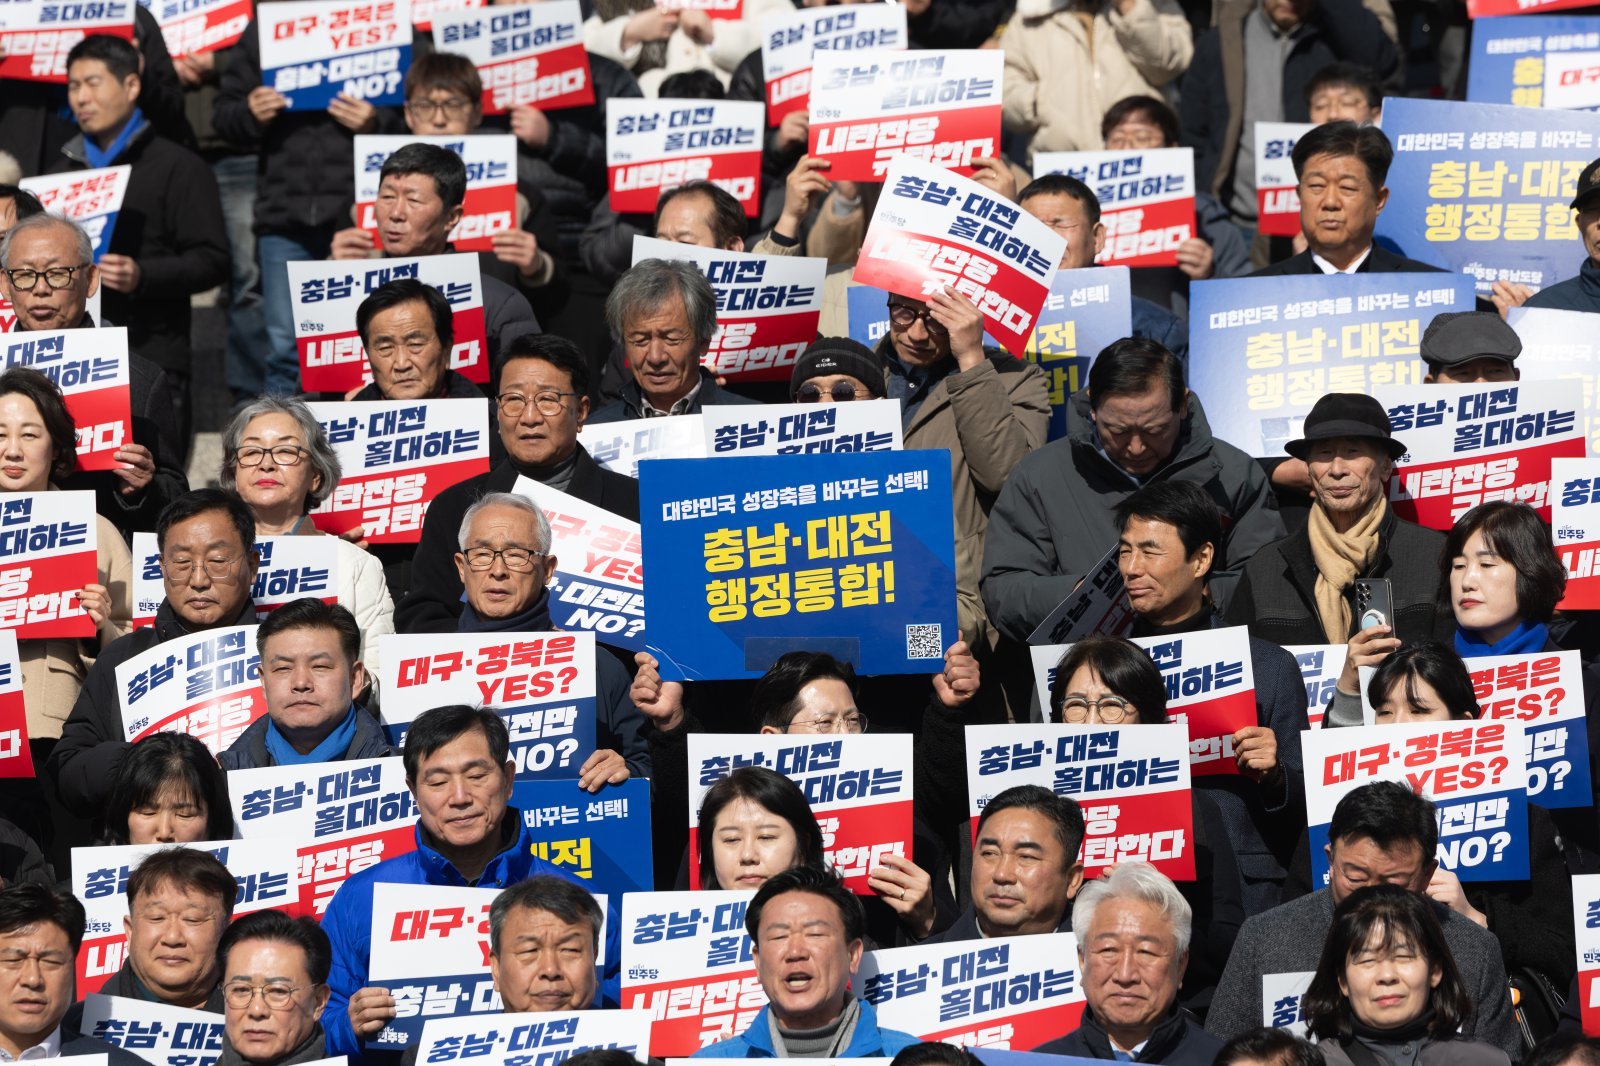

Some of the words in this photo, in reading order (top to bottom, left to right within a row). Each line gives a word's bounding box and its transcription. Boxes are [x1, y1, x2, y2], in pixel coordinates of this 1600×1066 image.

[273, 2, 395, 40] 대구·경북은
[331, 23, 398, 50] YES?
[443, 9, 531, 43] 충남·대전
[490, 21, 574, 57] 홀대하는
[343, 72, 402, 98] NO?
[822, 55, 945, 91] 충남·대전
[881, 76, 993, 110] 홀대하는
[616, 106, 715, 136] 충남·대전
[664, 126, 755, 152] 홀대하는
[1397, 133, 1465, 152] 대한민국
[1469, 130, 1538, 150] 성장축을
[1541, 131, 1593, 149] 바꾸는
[893, 175, 1021, 231] 충남·대전
[947, 215, 1052, 278] 홀대하는
[1070, 284, 1109, 307] 선택!
[1209, 304, 1278, 330] 대한민국
[1283, 297, 1353, 321] 성장축을
[1357, 293, 1410, 312] 바꾸는
[1414, 288, 1456, 305] 선택!
[300, 322, 324, 332] 민주당
[1246, 319, 1421, 369] 충남·대전
[320, 405, 427, 444] 남·대전
[1387, 387, 1518, 431] 충남·대전
[365, 429, 480, 468] 홀대하는
[715, 408, 837, 452] 충남·대전
[1454, 409, 1575, 452] 홀대하는
[662, 495, 736, 522] 대한민국
[742, 484, 817, 512] 성장축을
[822, 478, 879, 501] 바꾸는
[885, 469, 929, 494] 선택!
[703, 509, 893, 573] 충남·대전
[1557, 528, 1585, 539] 민주당
[705, 560, 896, 623] 행정통합!
[564, 608, 645, 639] NO?
[128, 630, 246, 705] 충남·대전
[397, 636, 575, 689] 대구·경북은
[476, 666, 578, 705] YES?
[129, 717, 149, 735] 민주당
[978, 730, 1119, 776] 충남·대전
[1323, 724, 1505, 786] 대구·경북은
[242, 764, 382, 820] 충남·대전
[800, 767, 903, 805] 대하는
[1053, 756, 1180, 795] 홀대하는
[1405, 756, 1509, 796] YES?
[1526, 761, 1571, 797] O?
[314, 790, 421, 838] 홀대하
[524, 806, 579, 828] 바꾸는
[585, 798, 629, 822] 선택!
[1080, 829, 1186, 867] 탄한다
[633, 902, 750, 945] 충남·대
[629, 969, 659, 980] 민주당
[864, 944, 1010, 1005] 충남·대전
[940, 968, 1074, 1023] 홀대하는
[377, 1031, 408, 1044] 민주당
[427, 1017, 579, 1063] 충남·대전
